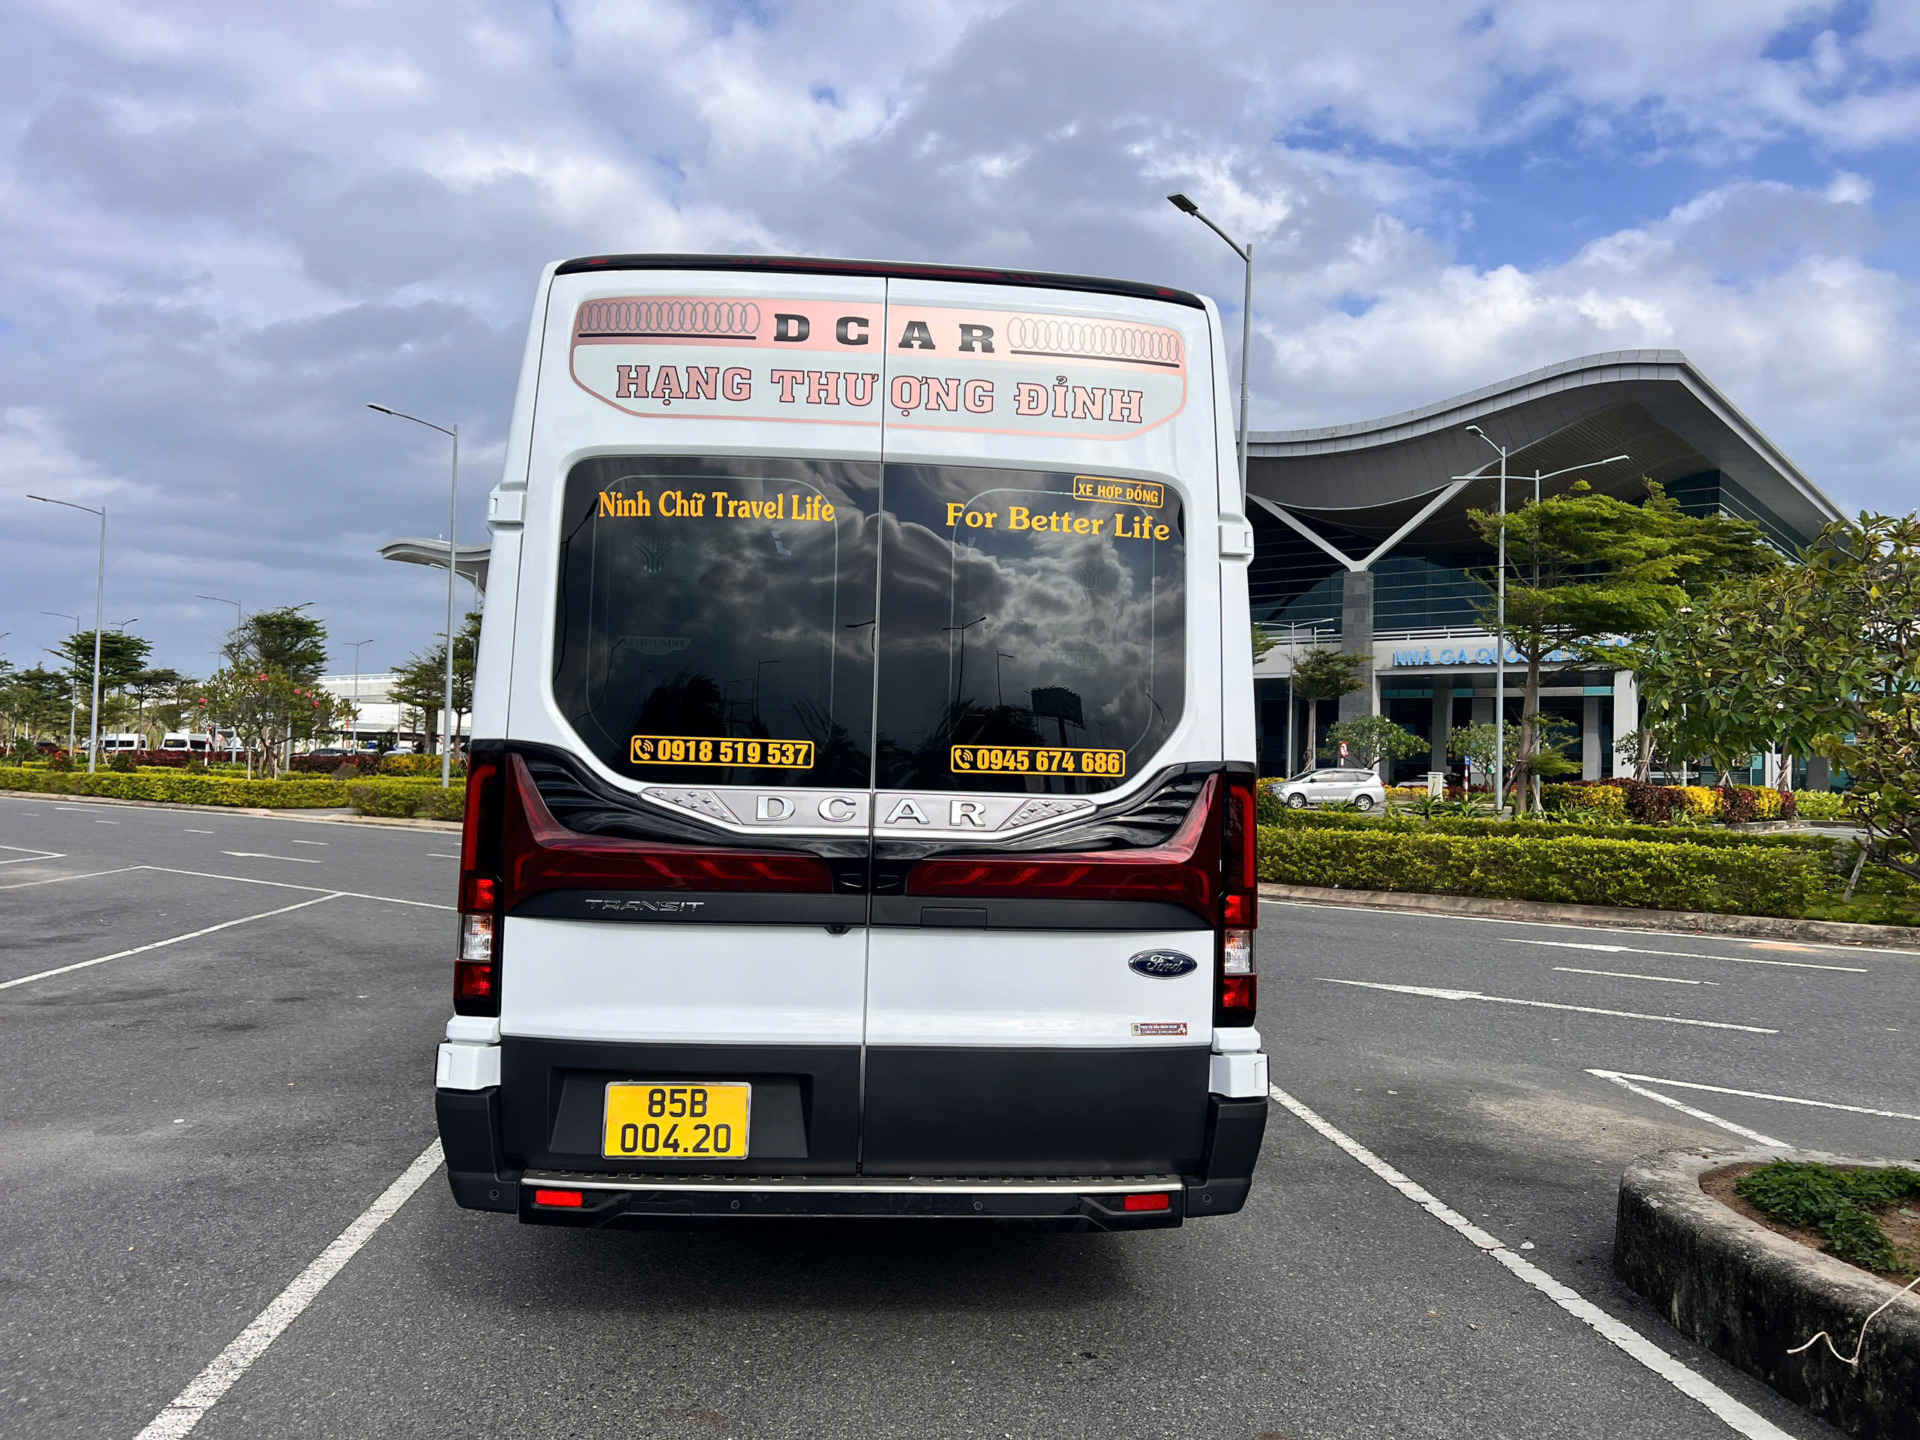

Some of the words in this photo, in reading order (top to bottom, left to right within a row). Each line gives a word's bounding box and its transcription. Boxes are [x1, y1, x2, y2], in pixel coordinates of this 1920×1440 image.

[774, 313, 995, 353] DCAR
[616, 365, 752, 406] HẠNG
[771, 369, 994, 417] THƯỢNG
[1013, 376, 1143, 423] ĐỈNH
[598, 491, 651, 518] Ninh
[658, 490, 706, 518] Chữ
[711, 491, 784, 520] Travel
[791, 494, 835, 522] Life
[1078, 483, 1094, 496] XE
[1097, 484, 1123, 500] HỢP
[1126, 484, 1159, 503] ĐỒNG
[946, 502, 998, 527] For
[1008, 506, 1104, 535] Better
[1114, 513, 1171, 541] Life
[1393, 645, 1435, 666] NHÀ
[1439, 648, 1470, 665] GA
[657, 740, 713, 762] 0918
[719, 742, 761, 763] 519
[767, 743, 808, 765] 537
[976, 749, 1030, 771] 0945
[1036, 751, 1075, 772] 674
[1081, 752, 1121, 774] 686
[755, 795, 987, 828] DCAR
[585, 899, 704, 912] TRANSIT
[1146, 954, 1183, 973] Ford
[648, 1089, 708, 1118] 85B
[620, 1123, 731, 1153] 004.20
